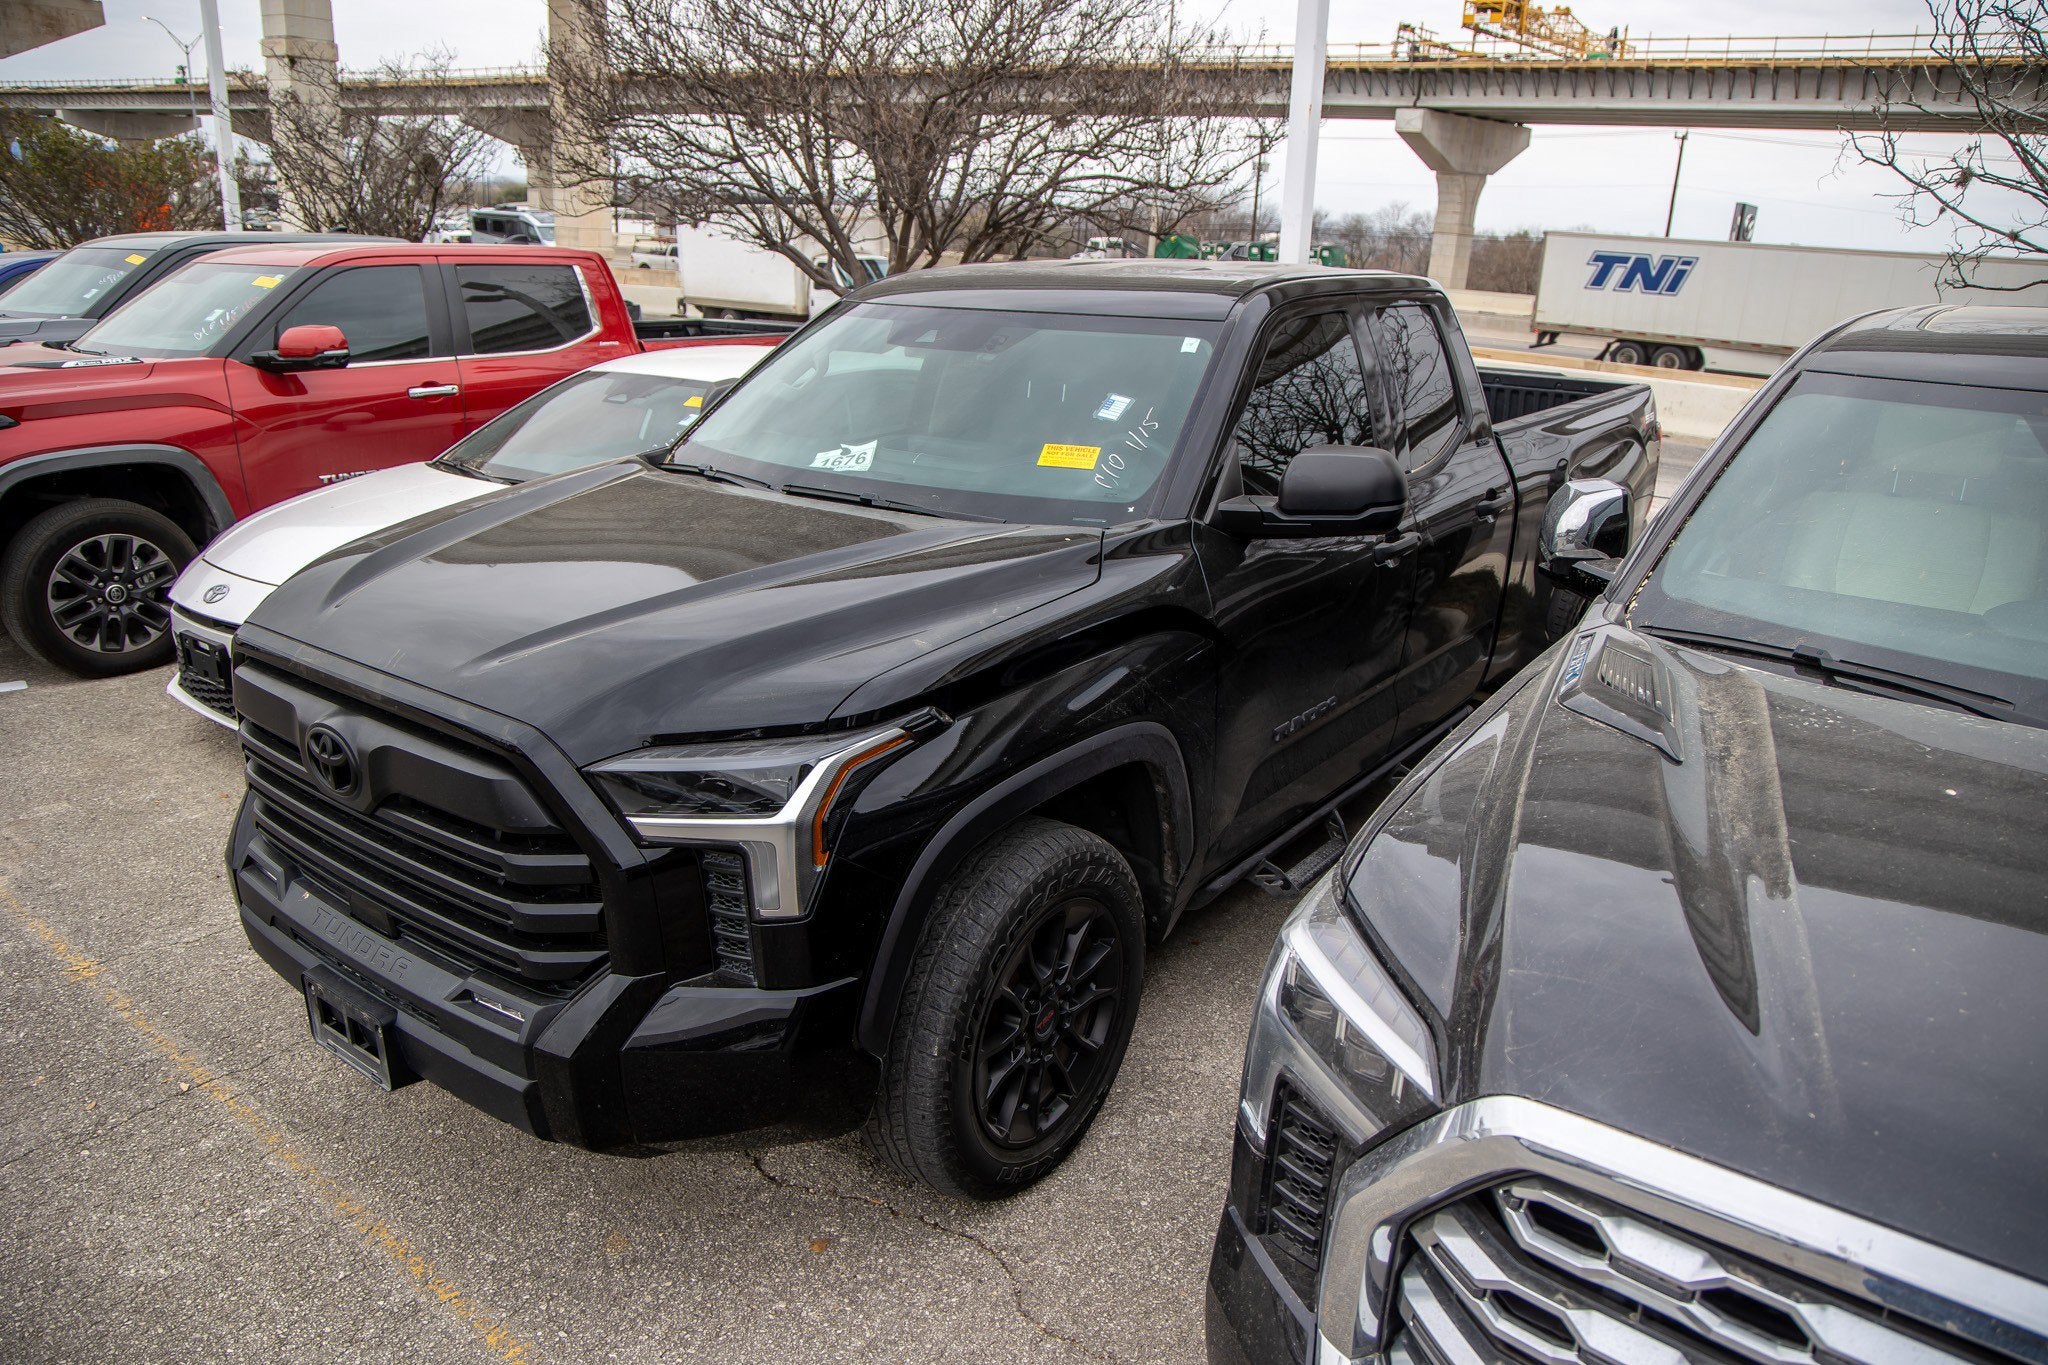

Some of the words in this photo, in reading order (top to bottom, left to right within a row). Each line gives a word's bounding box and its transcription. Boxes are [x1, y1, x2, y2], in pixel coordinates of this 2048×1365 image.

[1065, 446, 1098, 454] VEHICLE
[820, 451, 867, 467] 1676
[312, 906, 413, 982] TUNDRA
